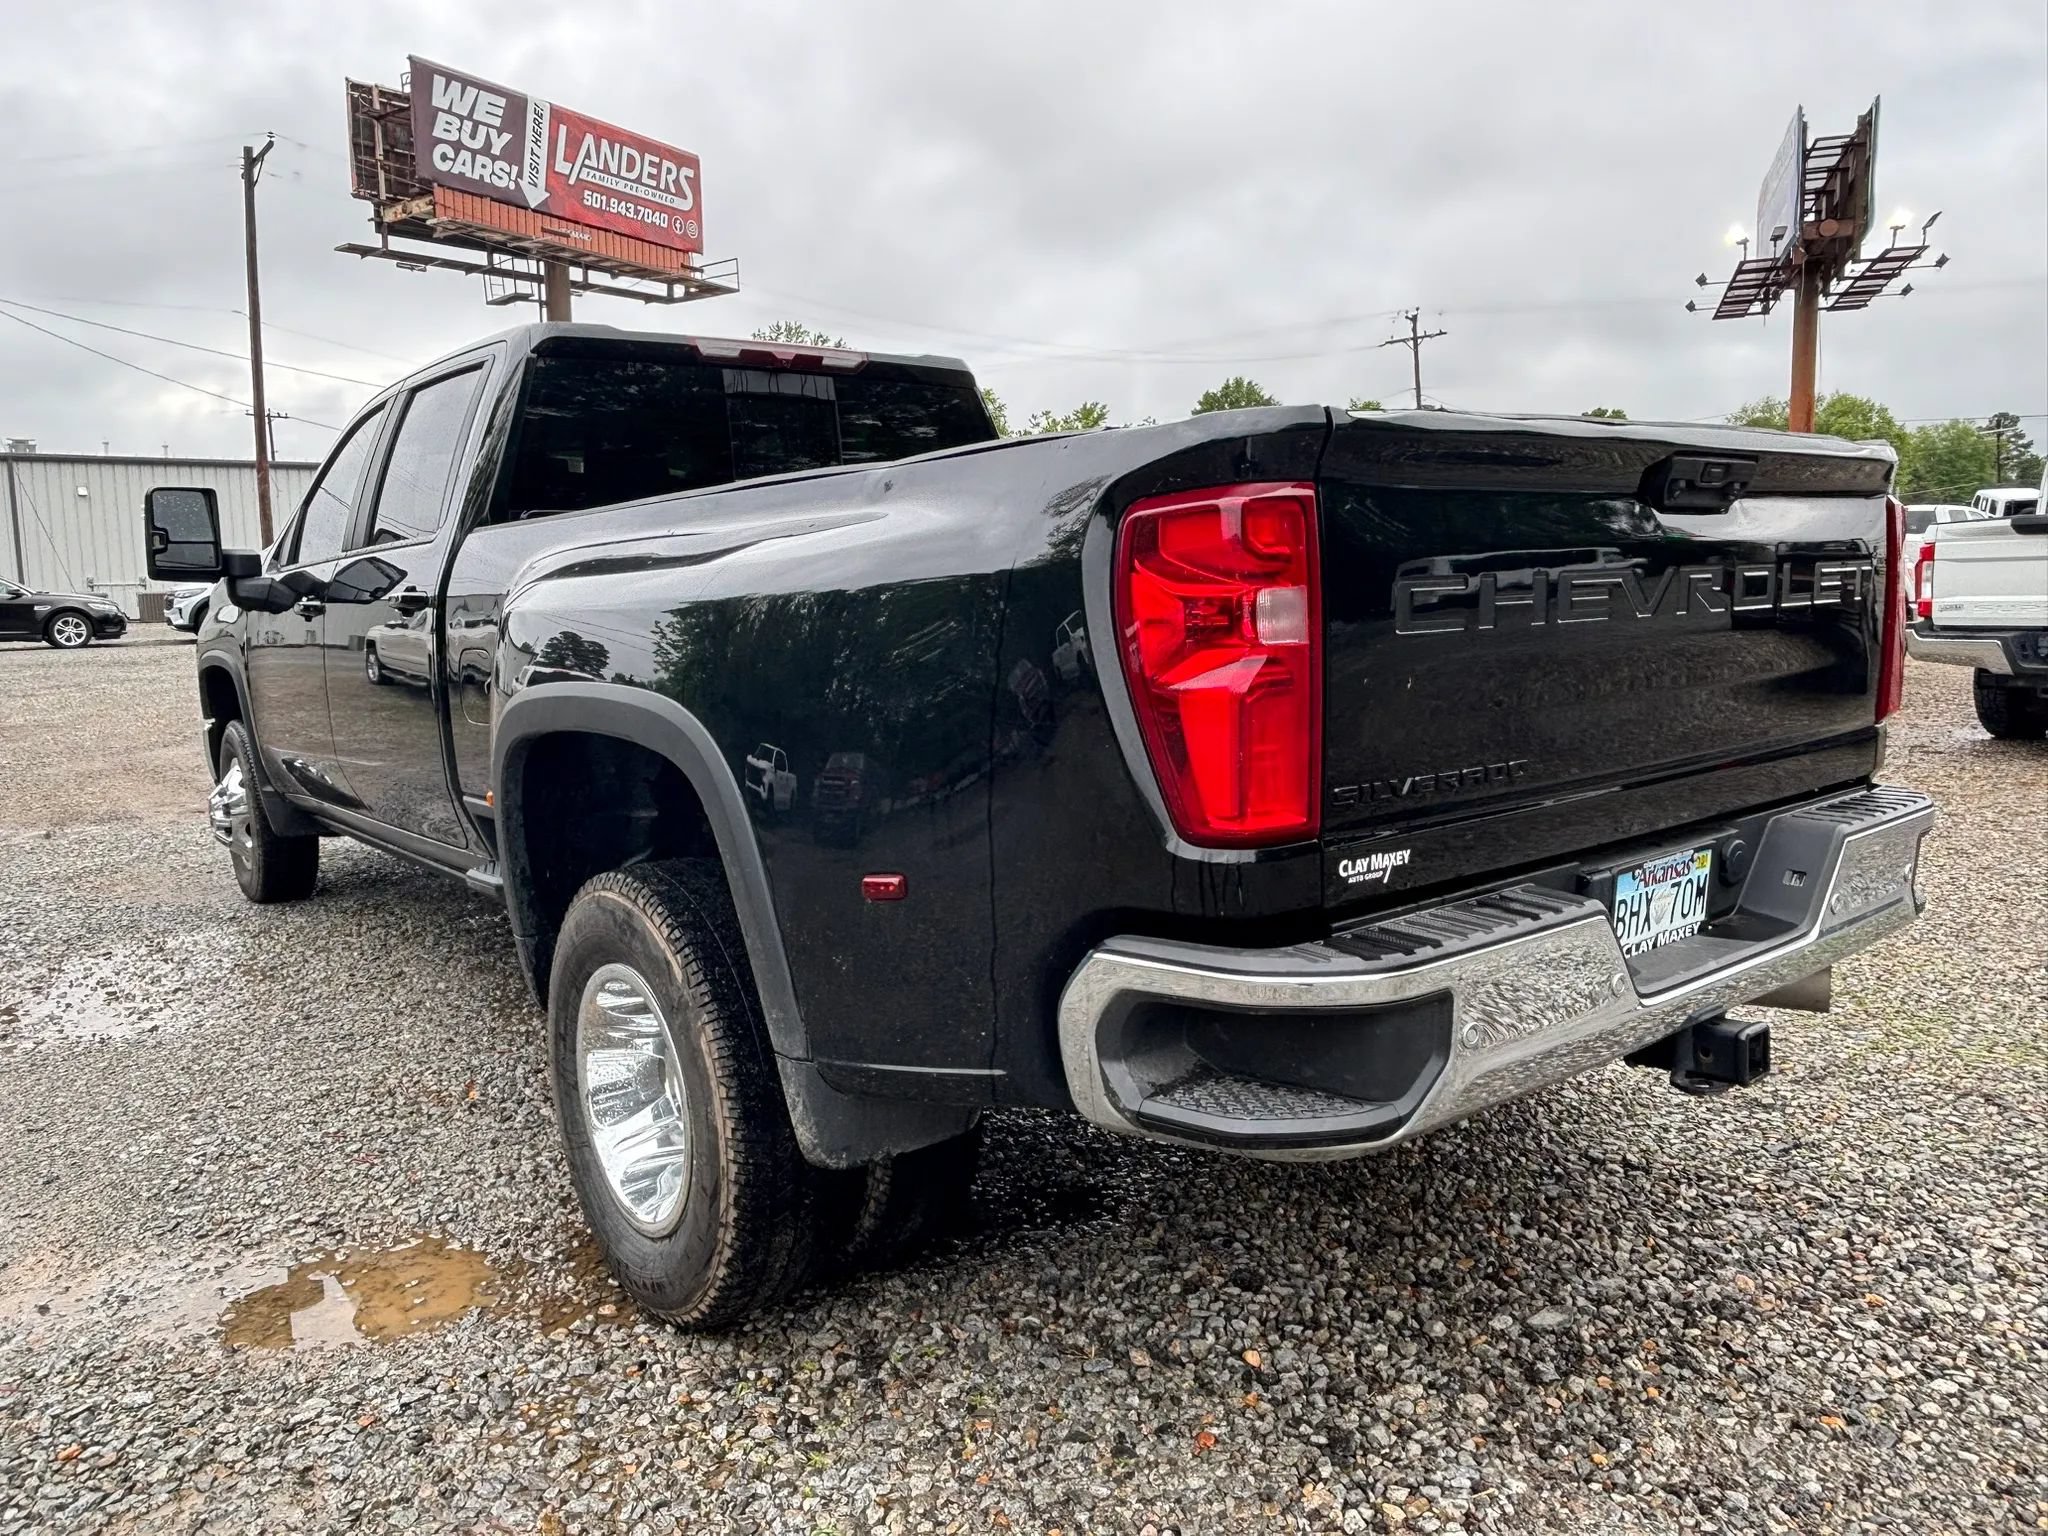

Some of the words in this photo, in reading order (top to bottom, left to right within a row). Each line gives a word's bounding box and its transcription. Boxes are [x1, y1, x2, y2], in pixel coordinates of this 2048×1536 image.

[432, 74, 506, 127] WE
[432, 111, 513, 156] BUY
[530, 102, 544, 149] HERE!
[432, 143, 518, 190] CARS!
[528, 147, 542, 188] VISIT
[554, 124, 695, 212] LANDERS
[586, 171, 620, 187] FAMILY
[583, 189, 668, 228] 501.943.7040
[1395, 560, 1872, 634] CHEVROLET
[1338, 857, 1370, 877] CLAY
[1371, 849, 1411, 884] MAXEY
[1364, 870, 1384, 881] GROUP
[1635, 860, 1691, 889] Arkansas
[1616, 889, 1655, 939] BHX
[1670, 874, 1708, 924] 70M
[1623, 939, 1655, 959] CLAY
[1656, 922, 1700, 947] MAXEY
